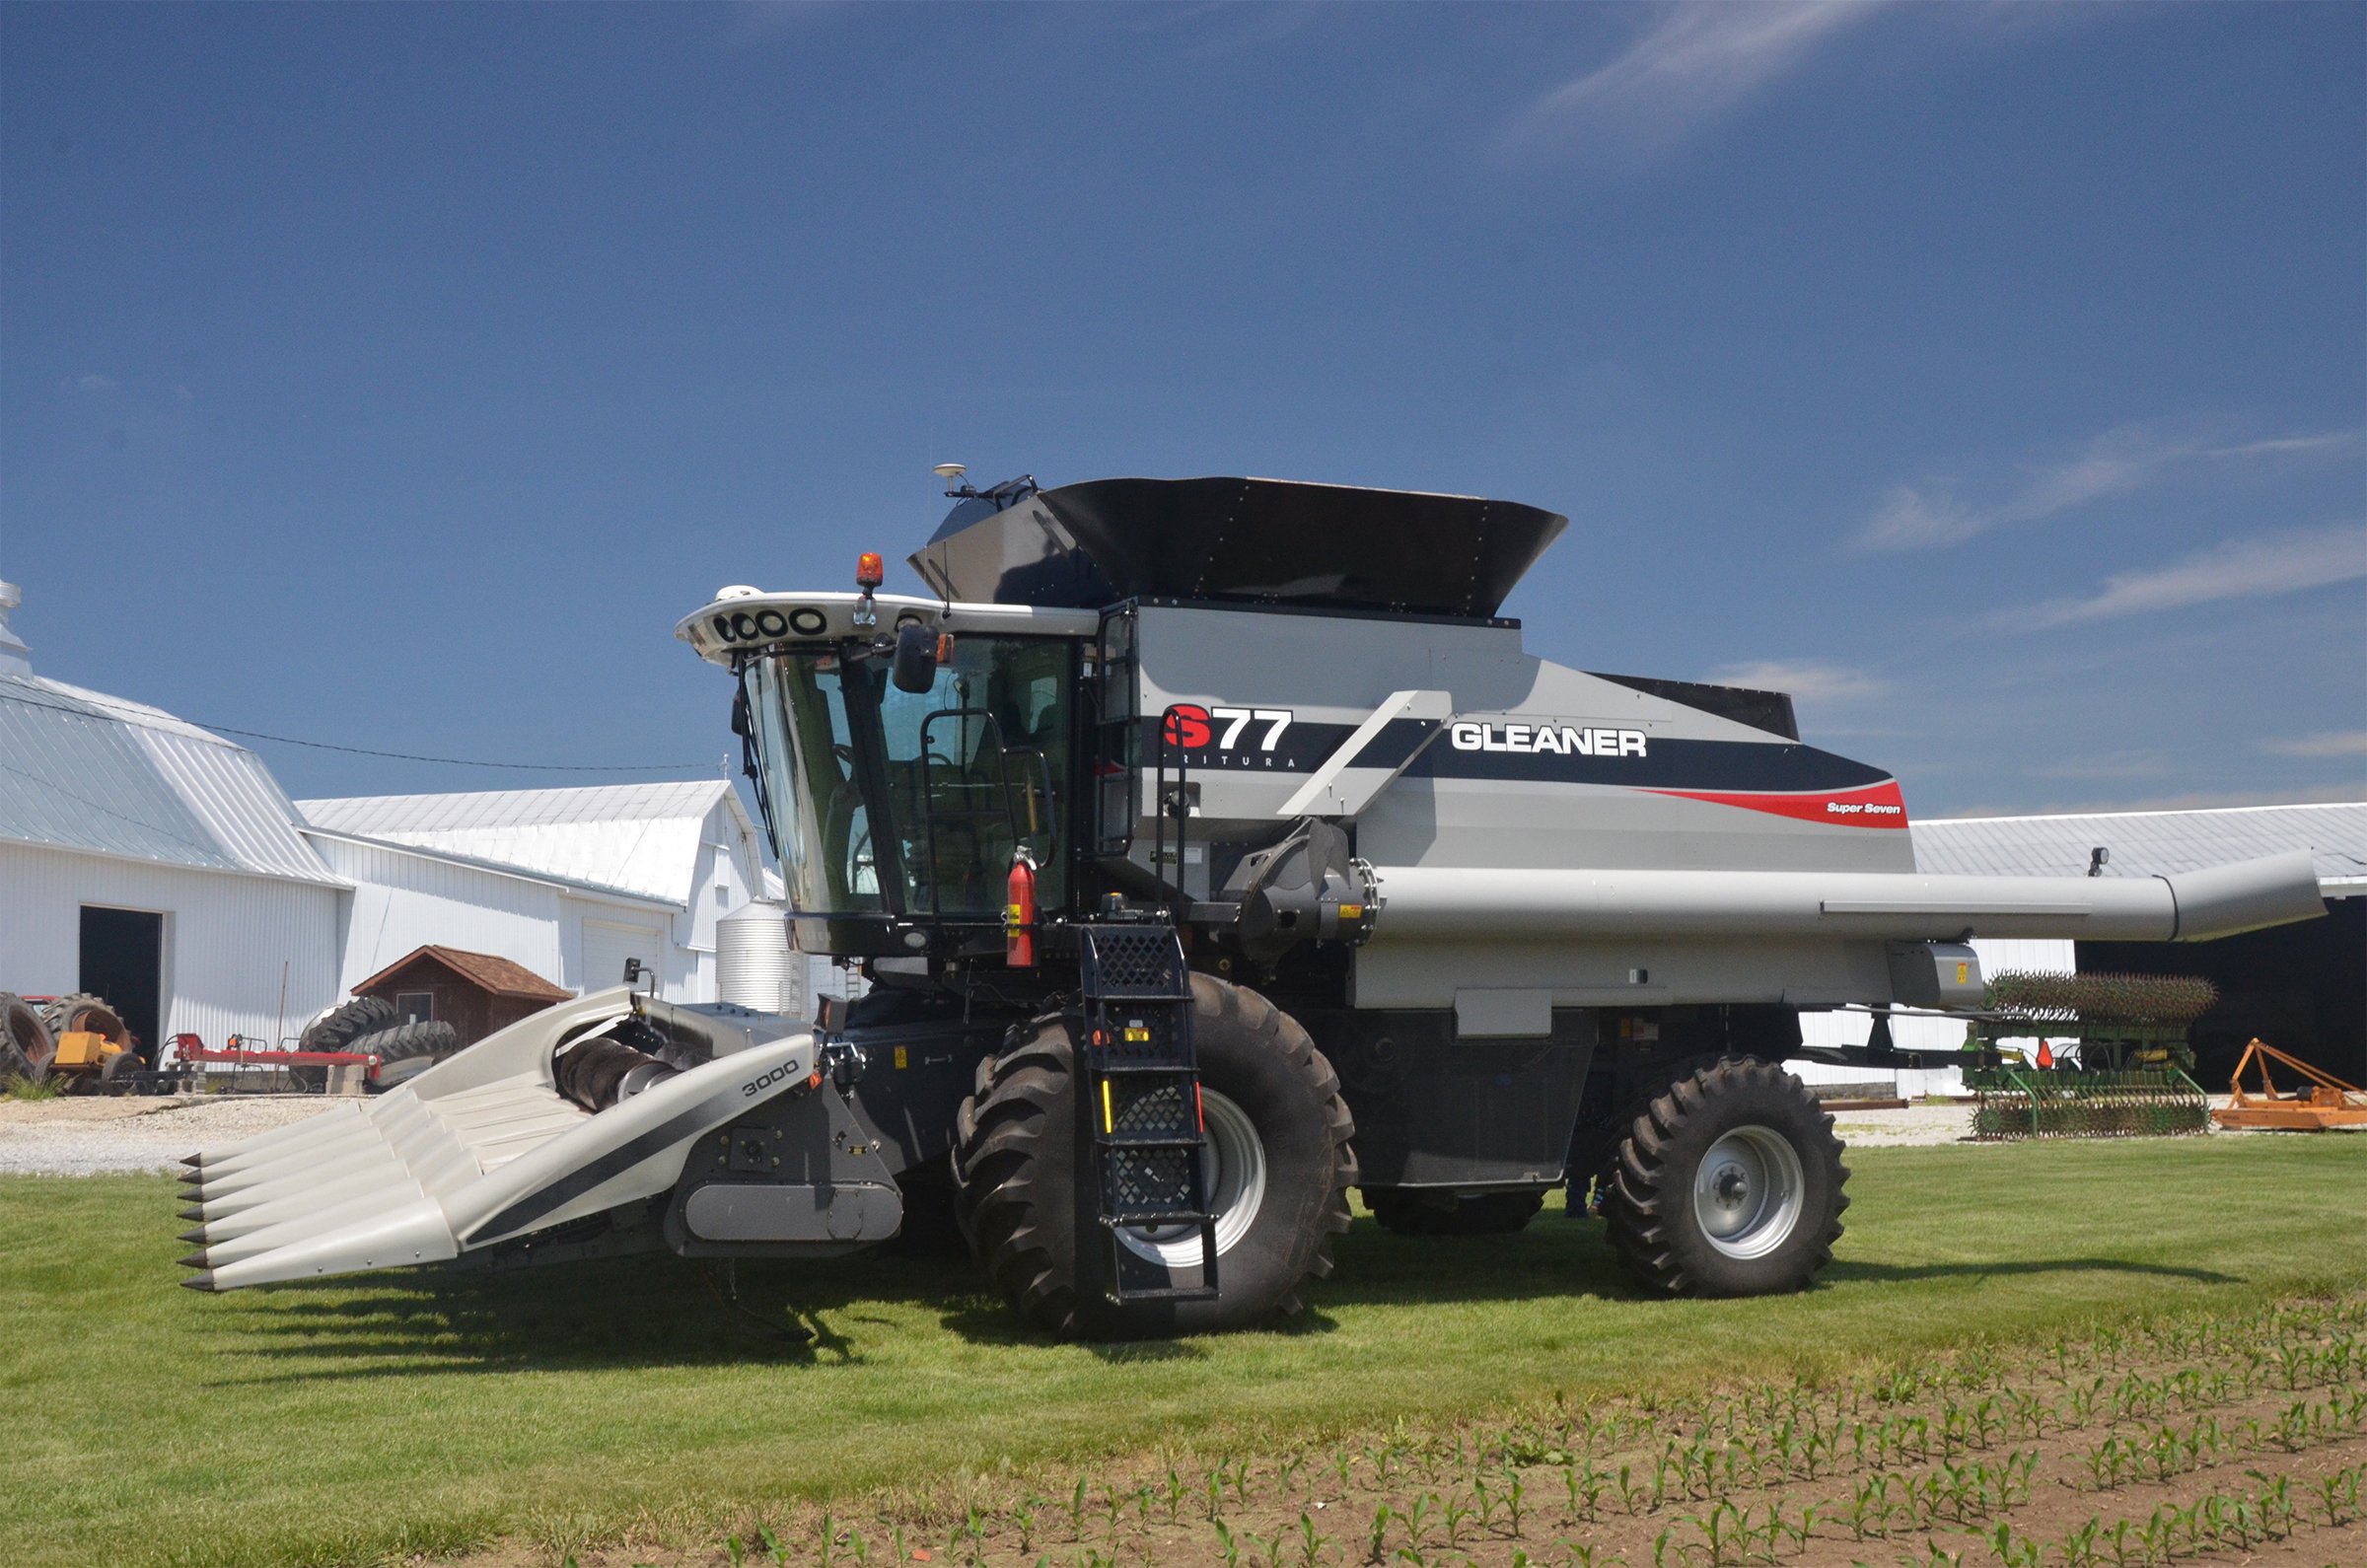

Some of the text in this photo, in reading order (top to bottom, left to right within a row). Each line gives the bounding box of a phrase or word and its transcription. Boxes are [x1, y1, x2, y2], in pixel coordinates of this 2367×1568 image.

[1164, 704, 1293, 751] S77
[1451, 722, 1647, 757] GLEANER
[1164, 753, 1295, 768] RITURA
[1827, 802, 1901, 815] Super Seven
[742, 1059, 799, 1097] 3000
